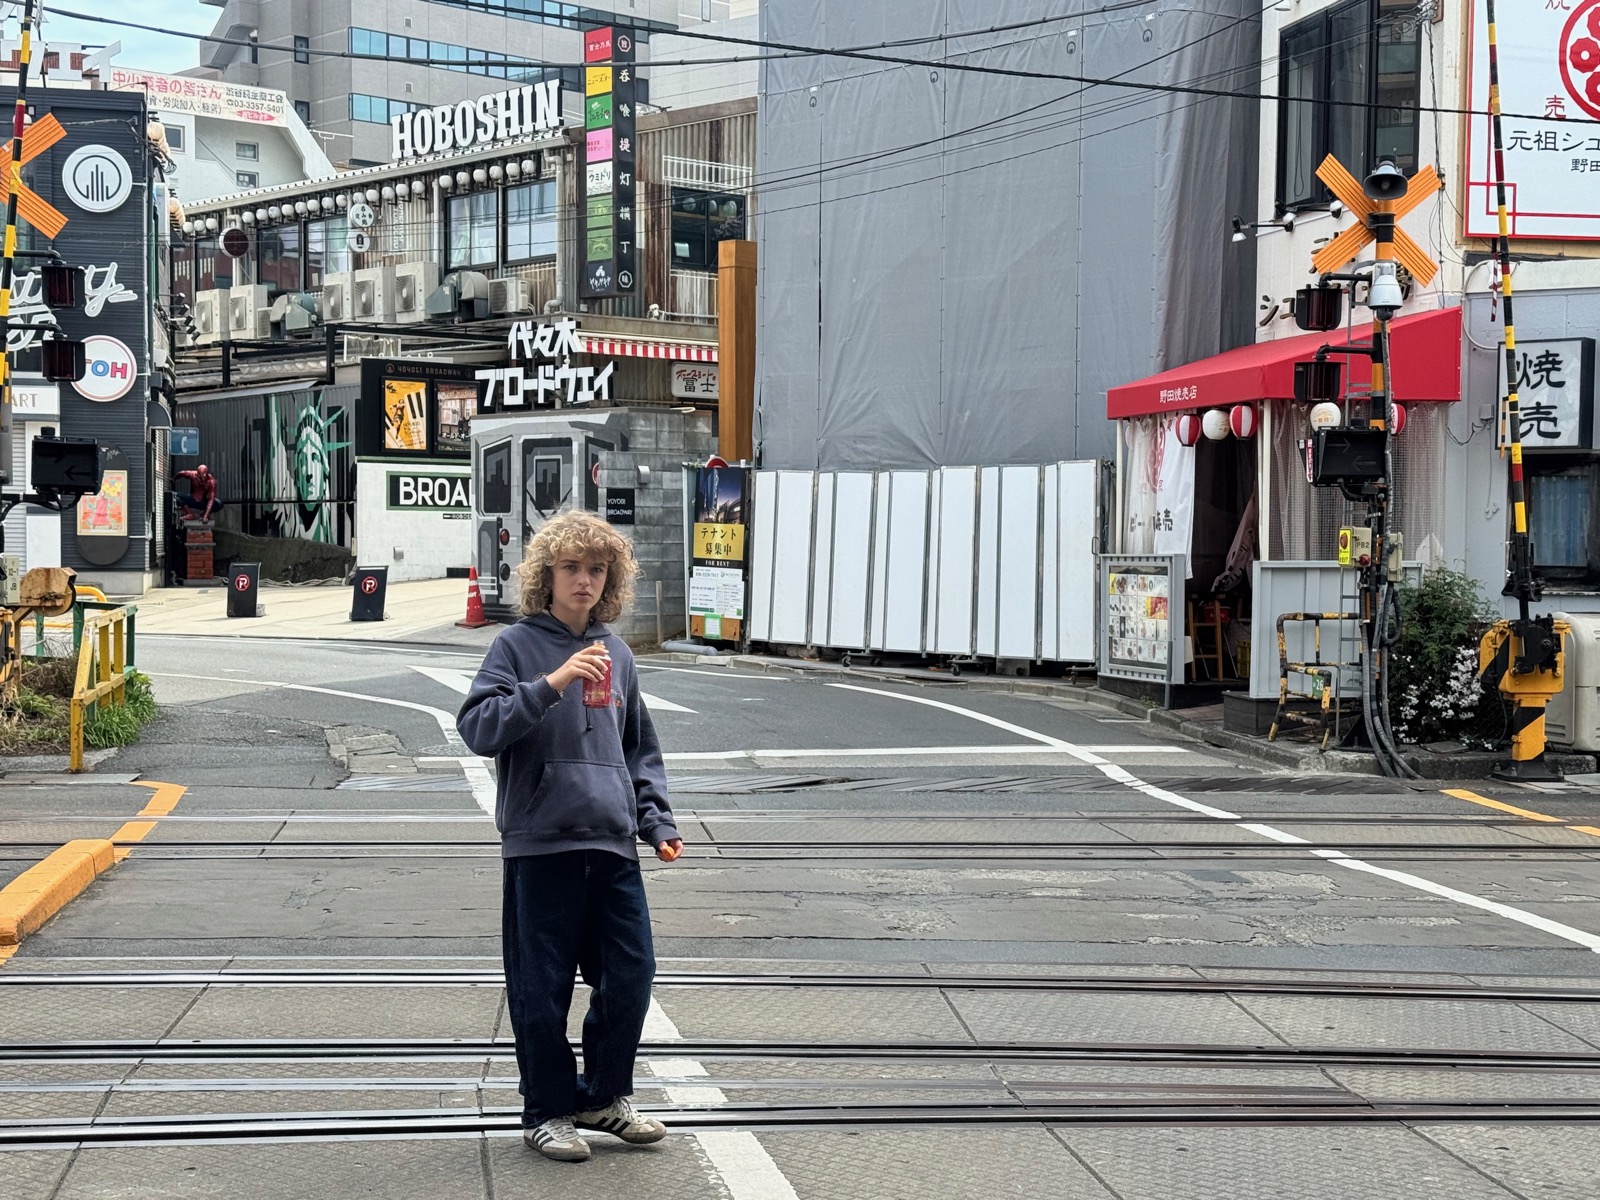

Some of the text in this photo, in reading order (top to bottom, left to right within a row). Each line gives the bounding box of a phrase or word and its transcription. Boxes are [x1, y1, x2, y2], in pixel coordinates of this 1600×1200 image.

[391, 78, 561, 160] HOBOSHIN
[508, 317, 583, 359] 代々木
[86, 359, 128, 379] OH
[1160, 385, 1198, 404] 野田焼売店
[400, 476, 471, 506] BROA
[701, 527, 737, 540] テナント
[705, 542, 732, 556] 募集中
